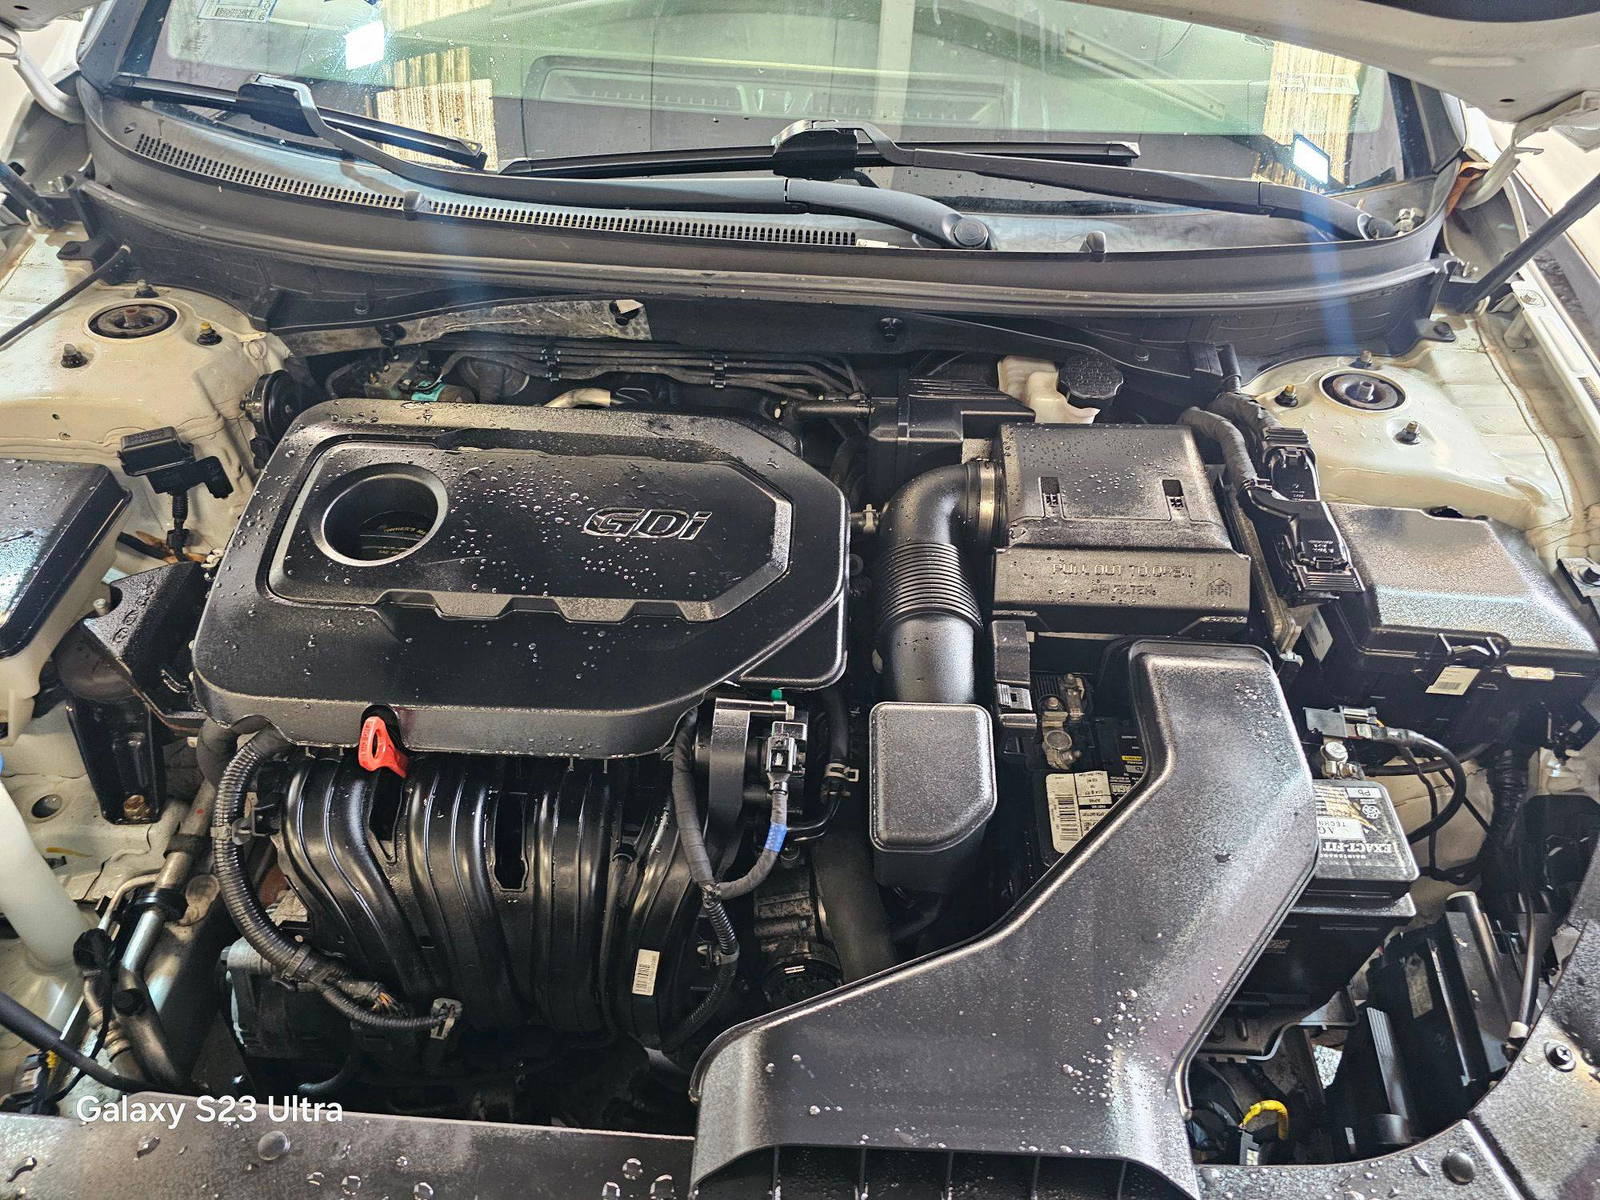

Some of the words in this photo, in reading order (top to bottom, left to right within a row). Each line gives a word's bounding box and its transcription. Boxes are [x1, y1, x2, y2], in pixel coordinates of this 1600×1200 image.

[1094, 564, 1123, 577] OUT
[1129, 563, 1149, 577] TO
[1322, 842, 1392, 854] EXACT-FIT
